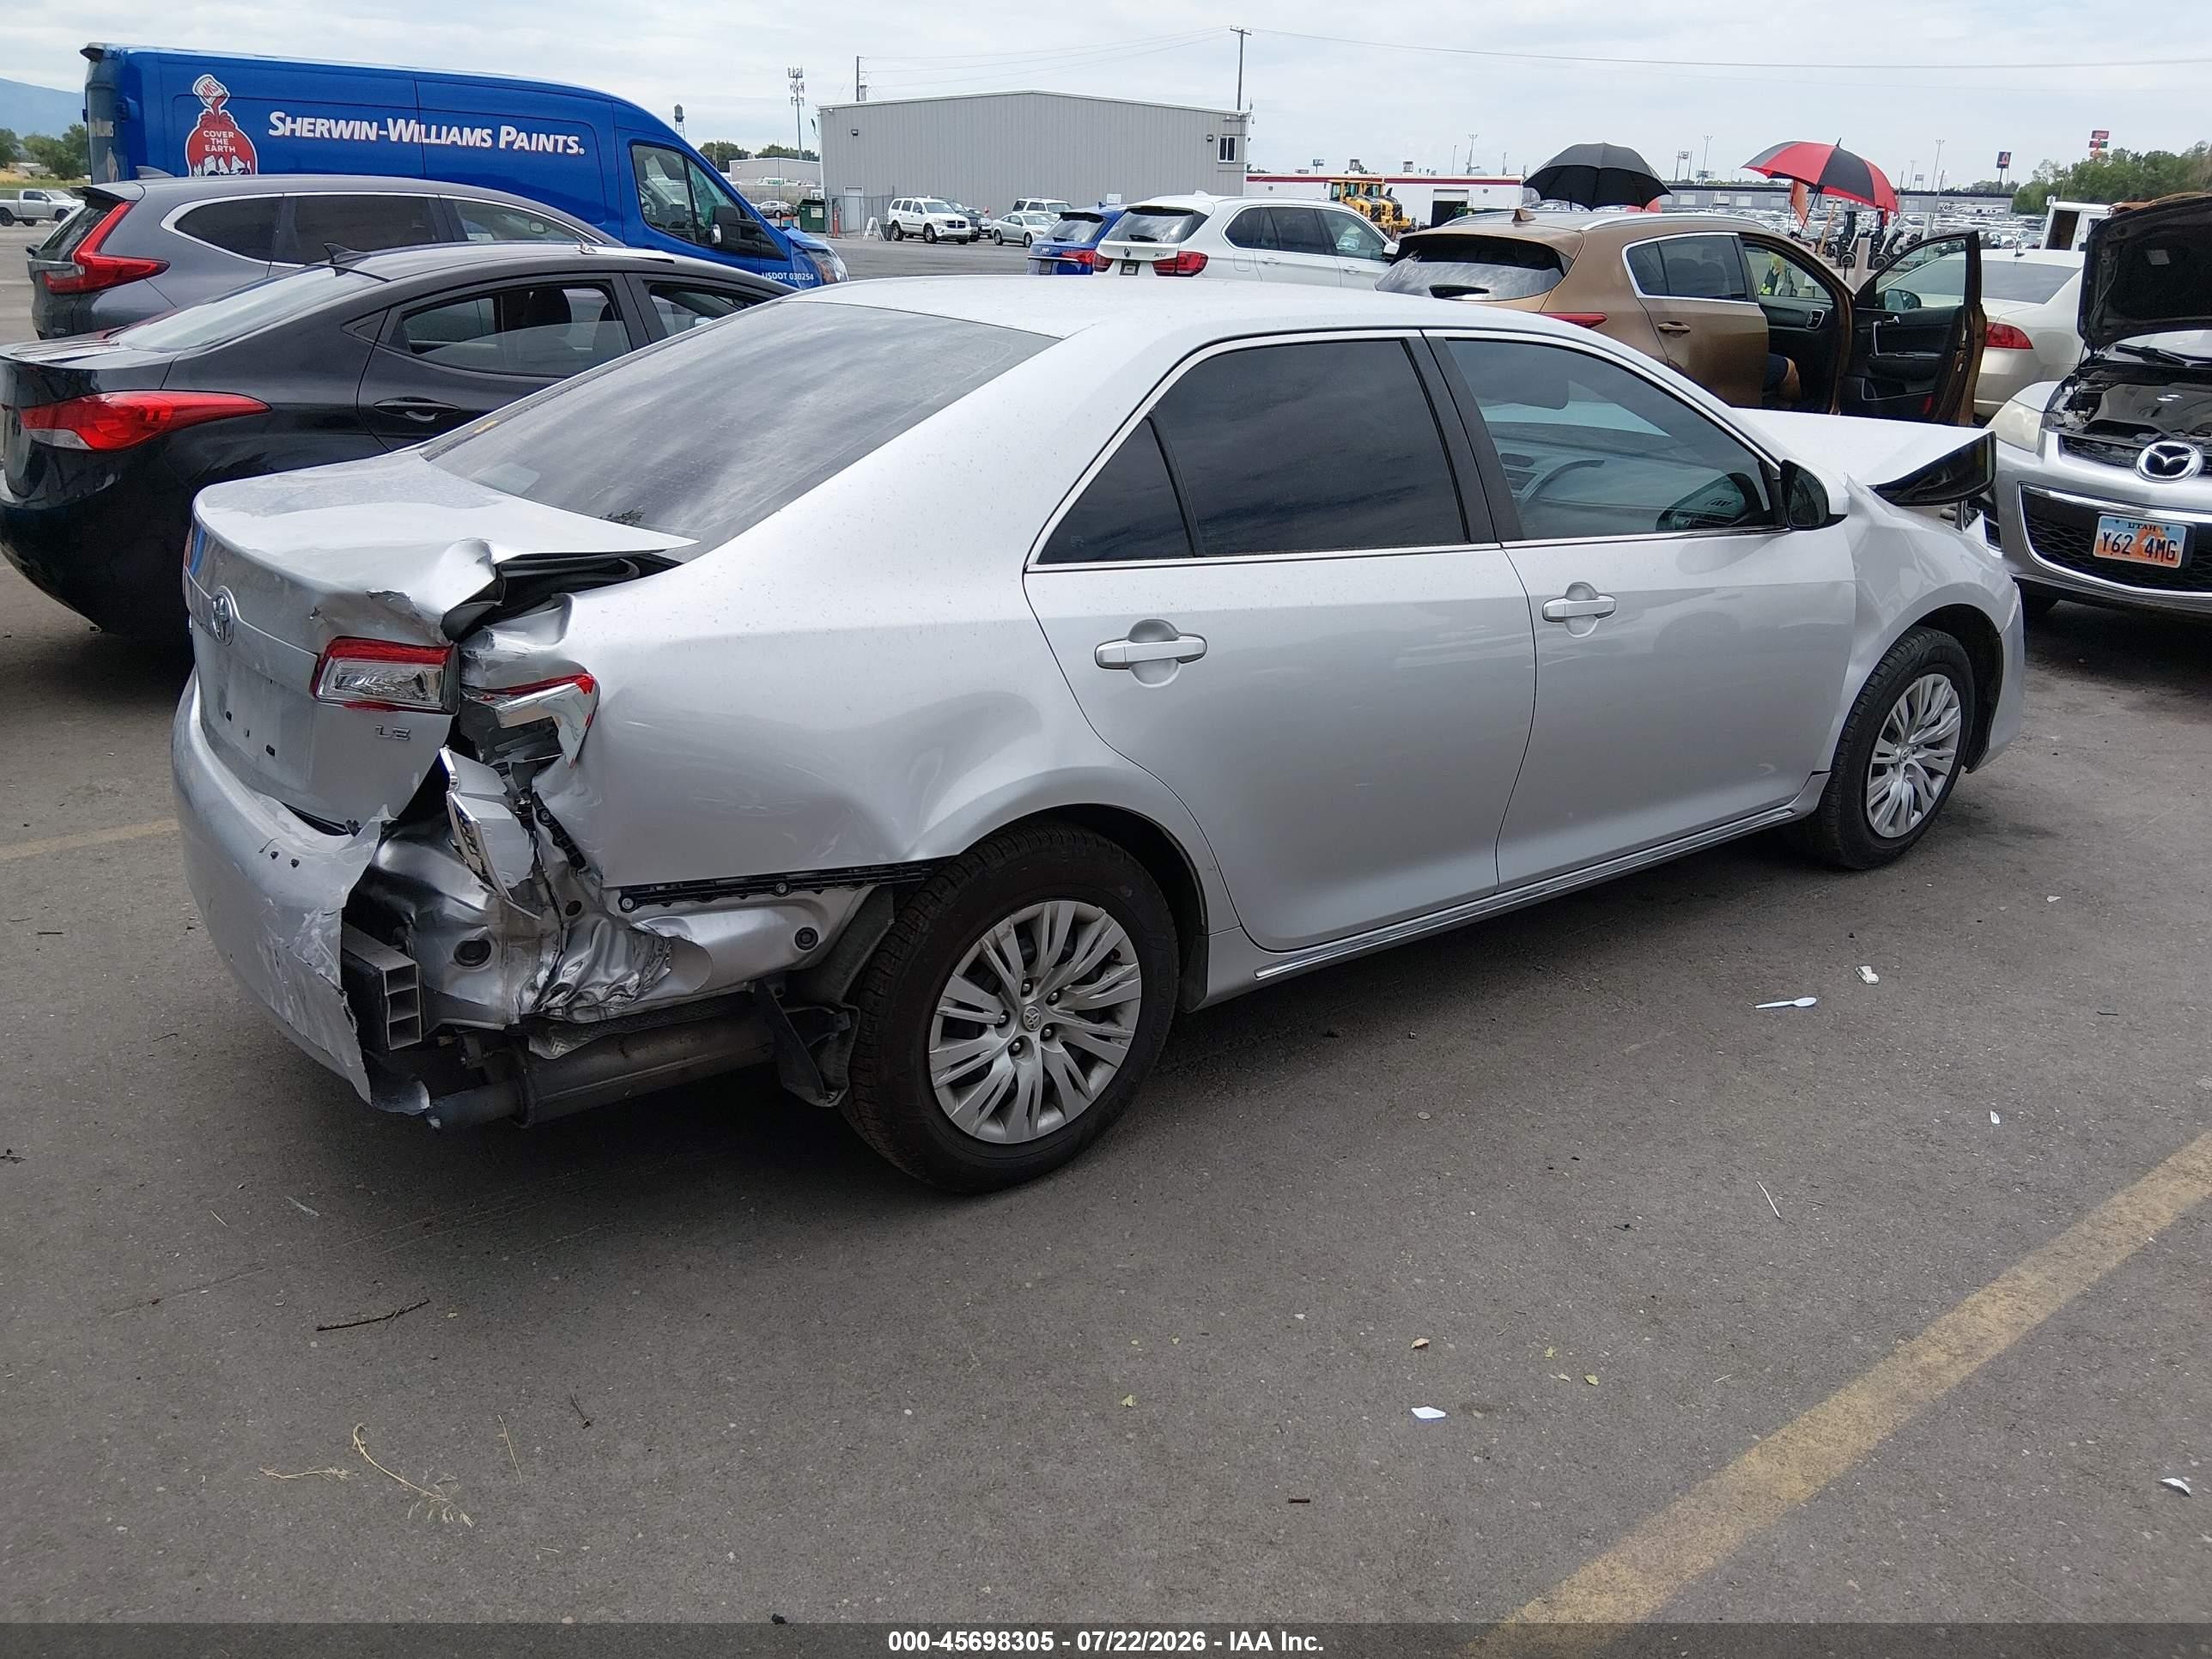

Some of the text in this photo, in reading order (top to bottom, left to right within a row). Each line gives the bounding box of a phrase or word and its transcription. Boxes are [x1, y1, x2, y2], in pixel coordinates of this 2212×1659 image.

[203, 130, 234, 138] COVER
[269, 112, 492, 149] SHERWIN-WILLIAMS
[204, 144, 236, 153] EARTH
[763, 271, 815, 282] USDOT 030254
[2126, 521, 2158, 532] UTAH
[2102, 532, 2179, 562] Y62 4MG
[374, 725, 410, 741] LE
